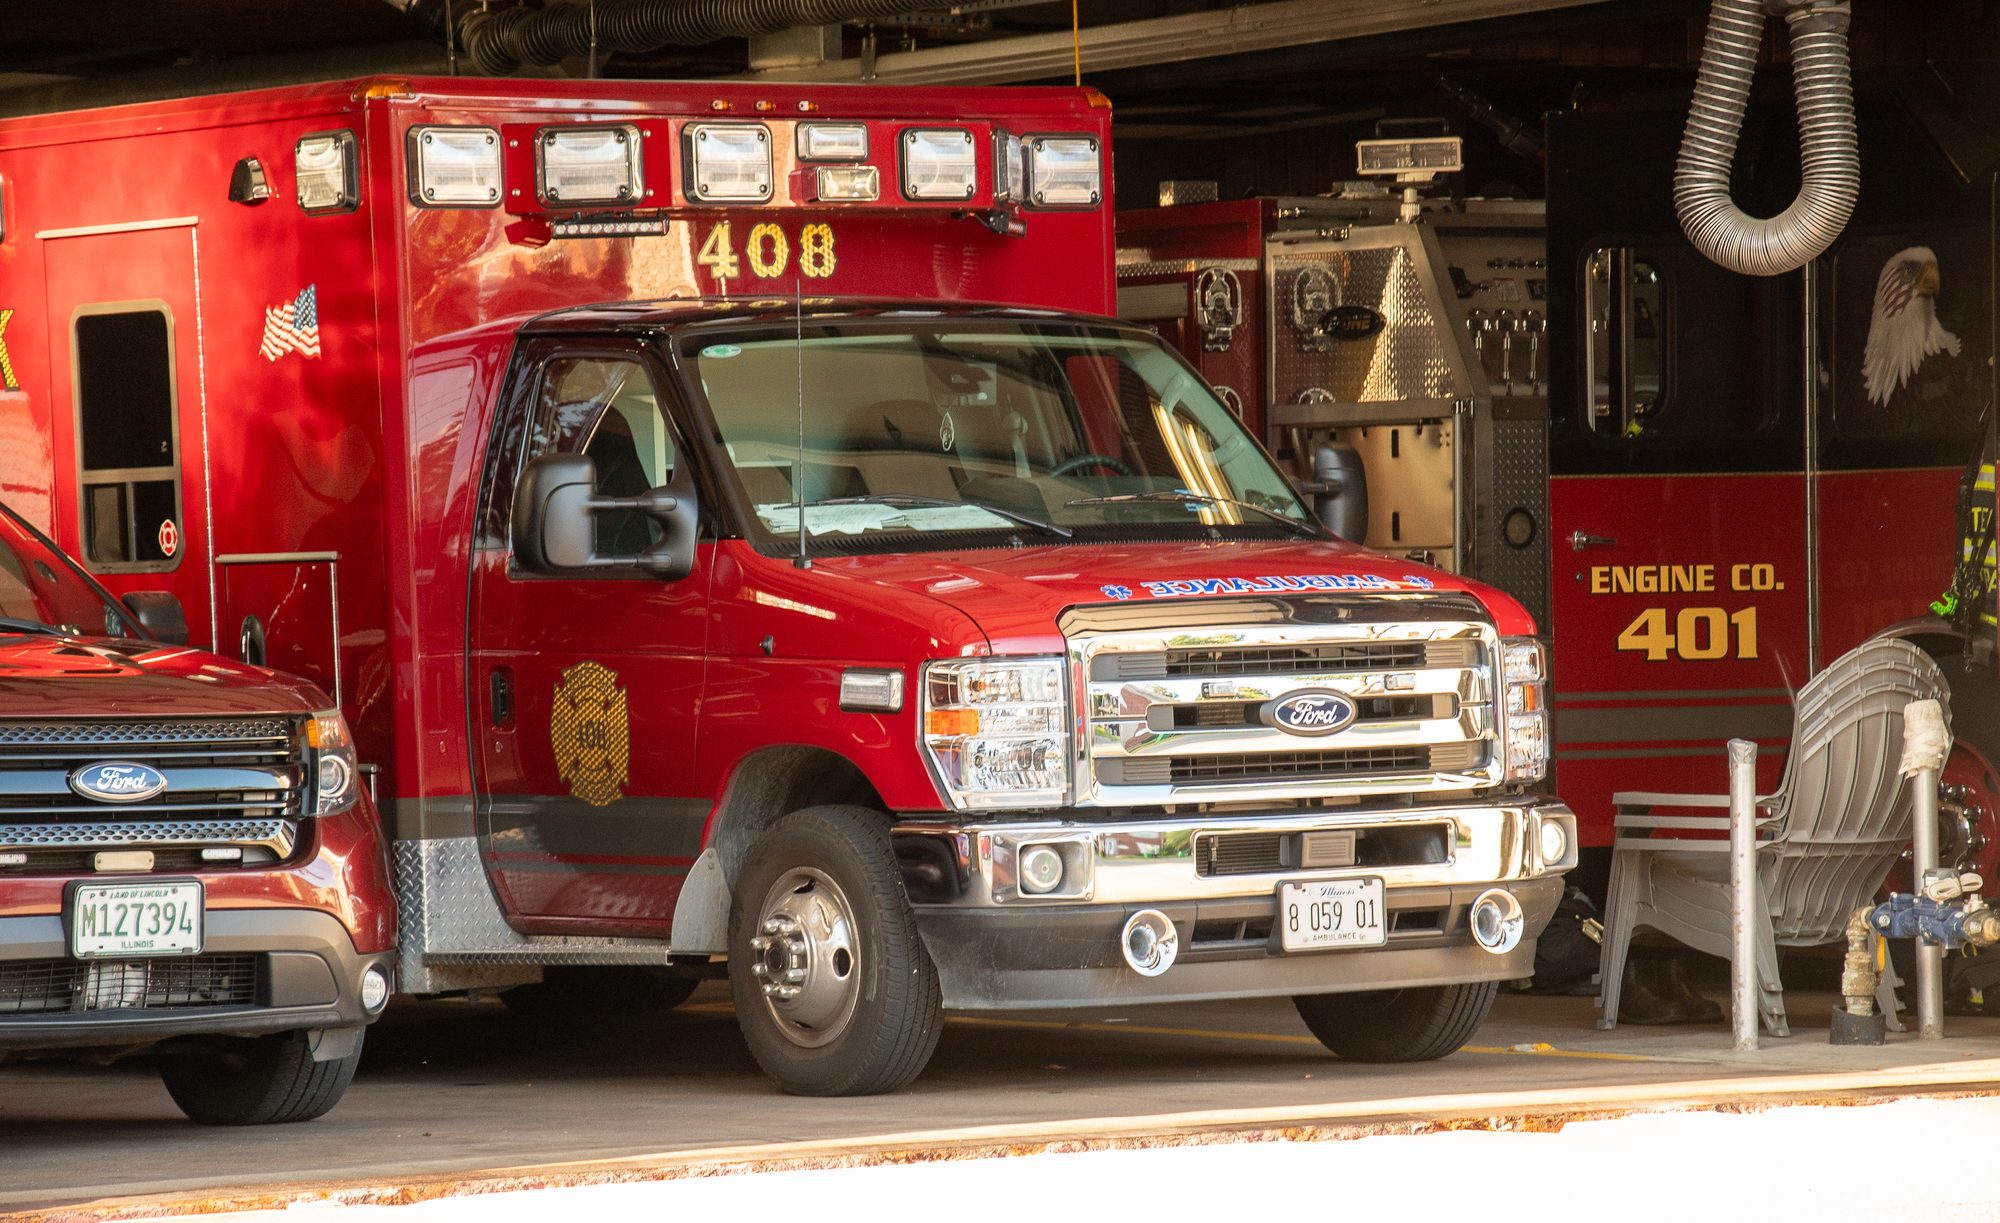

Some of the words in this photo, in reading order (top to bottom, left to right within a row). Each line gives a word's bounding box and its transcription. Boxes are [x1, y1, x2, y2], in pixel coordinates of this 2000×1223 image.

[698, 222, 838, 278] 408
[1590, 564, 1716, 594] ENGINE
[1731, 563, 1785, 591] CO.
[1617, 606, 1759, 661] 401
[1290, 699, 1338, 725] Ford
[96, 766, 147, 790] Ford
[139, 890, 169, 898] LINCOLN
[1320, 886, 1355, 897] Illinois
[81, 901, 193, 937] M127394
[1289, 903, 1299, 932] 8
[1310, 901, 1343, 931] 059
[1356, 899, 1378, 928] 01
[121, 940, 154, 949] ILLINOIS
[1312, 932, 1357, 942] AMBULANCE
